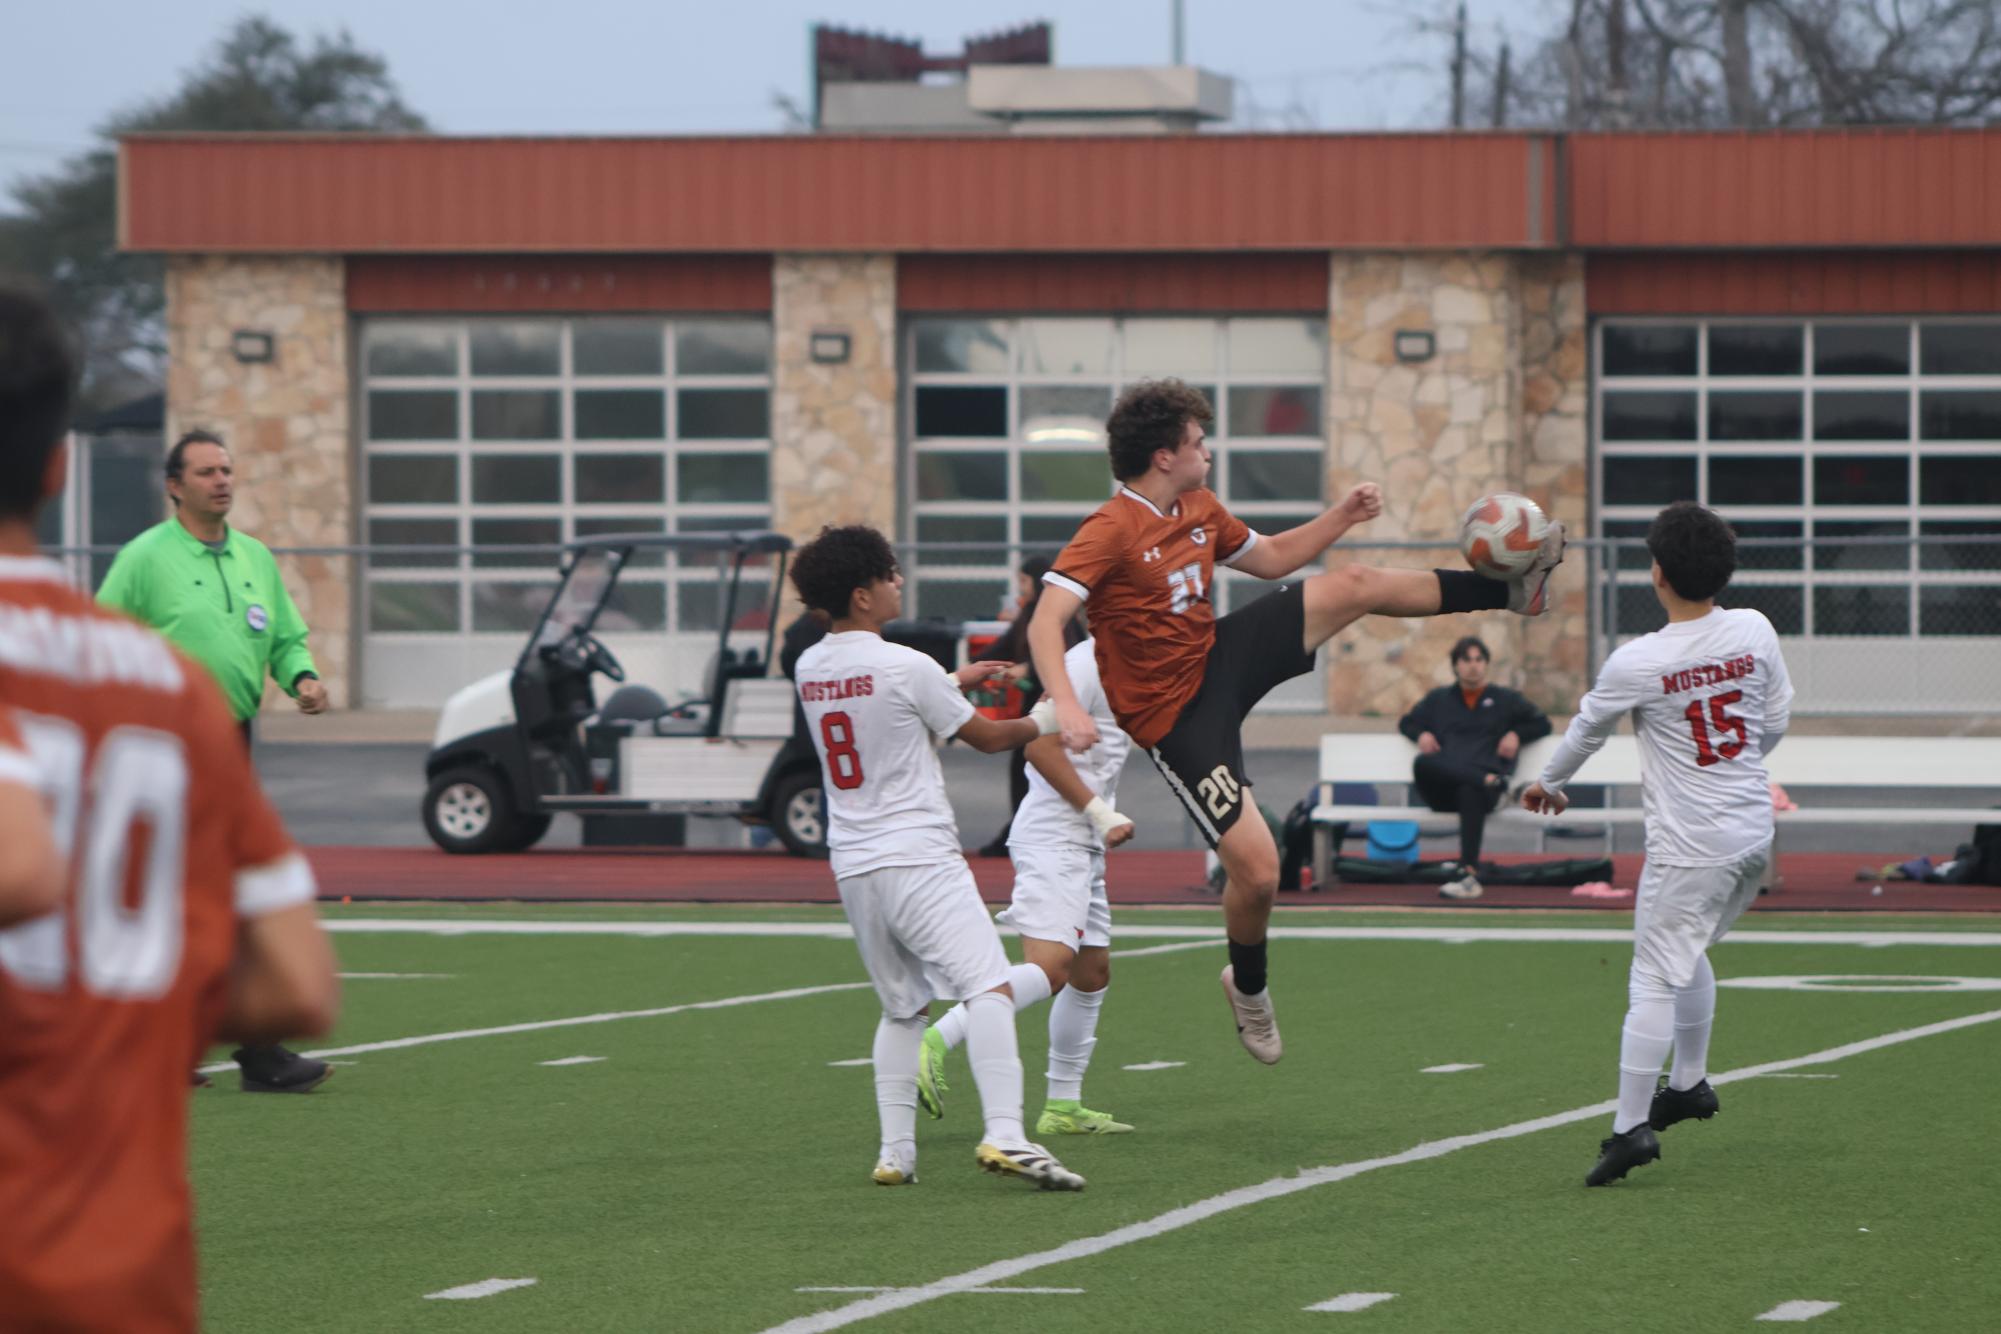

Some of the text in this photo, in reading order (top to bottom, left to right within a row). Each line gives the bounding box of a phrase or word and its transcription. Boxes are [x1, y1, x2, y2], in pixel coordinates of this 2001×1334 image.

[1662, 655, 1754, 694] MUSTANGS
[820, 711, 864, 790] 8
[1685, 689, 1749, 767] 15
[1197, 765, 1239, 819] 20
